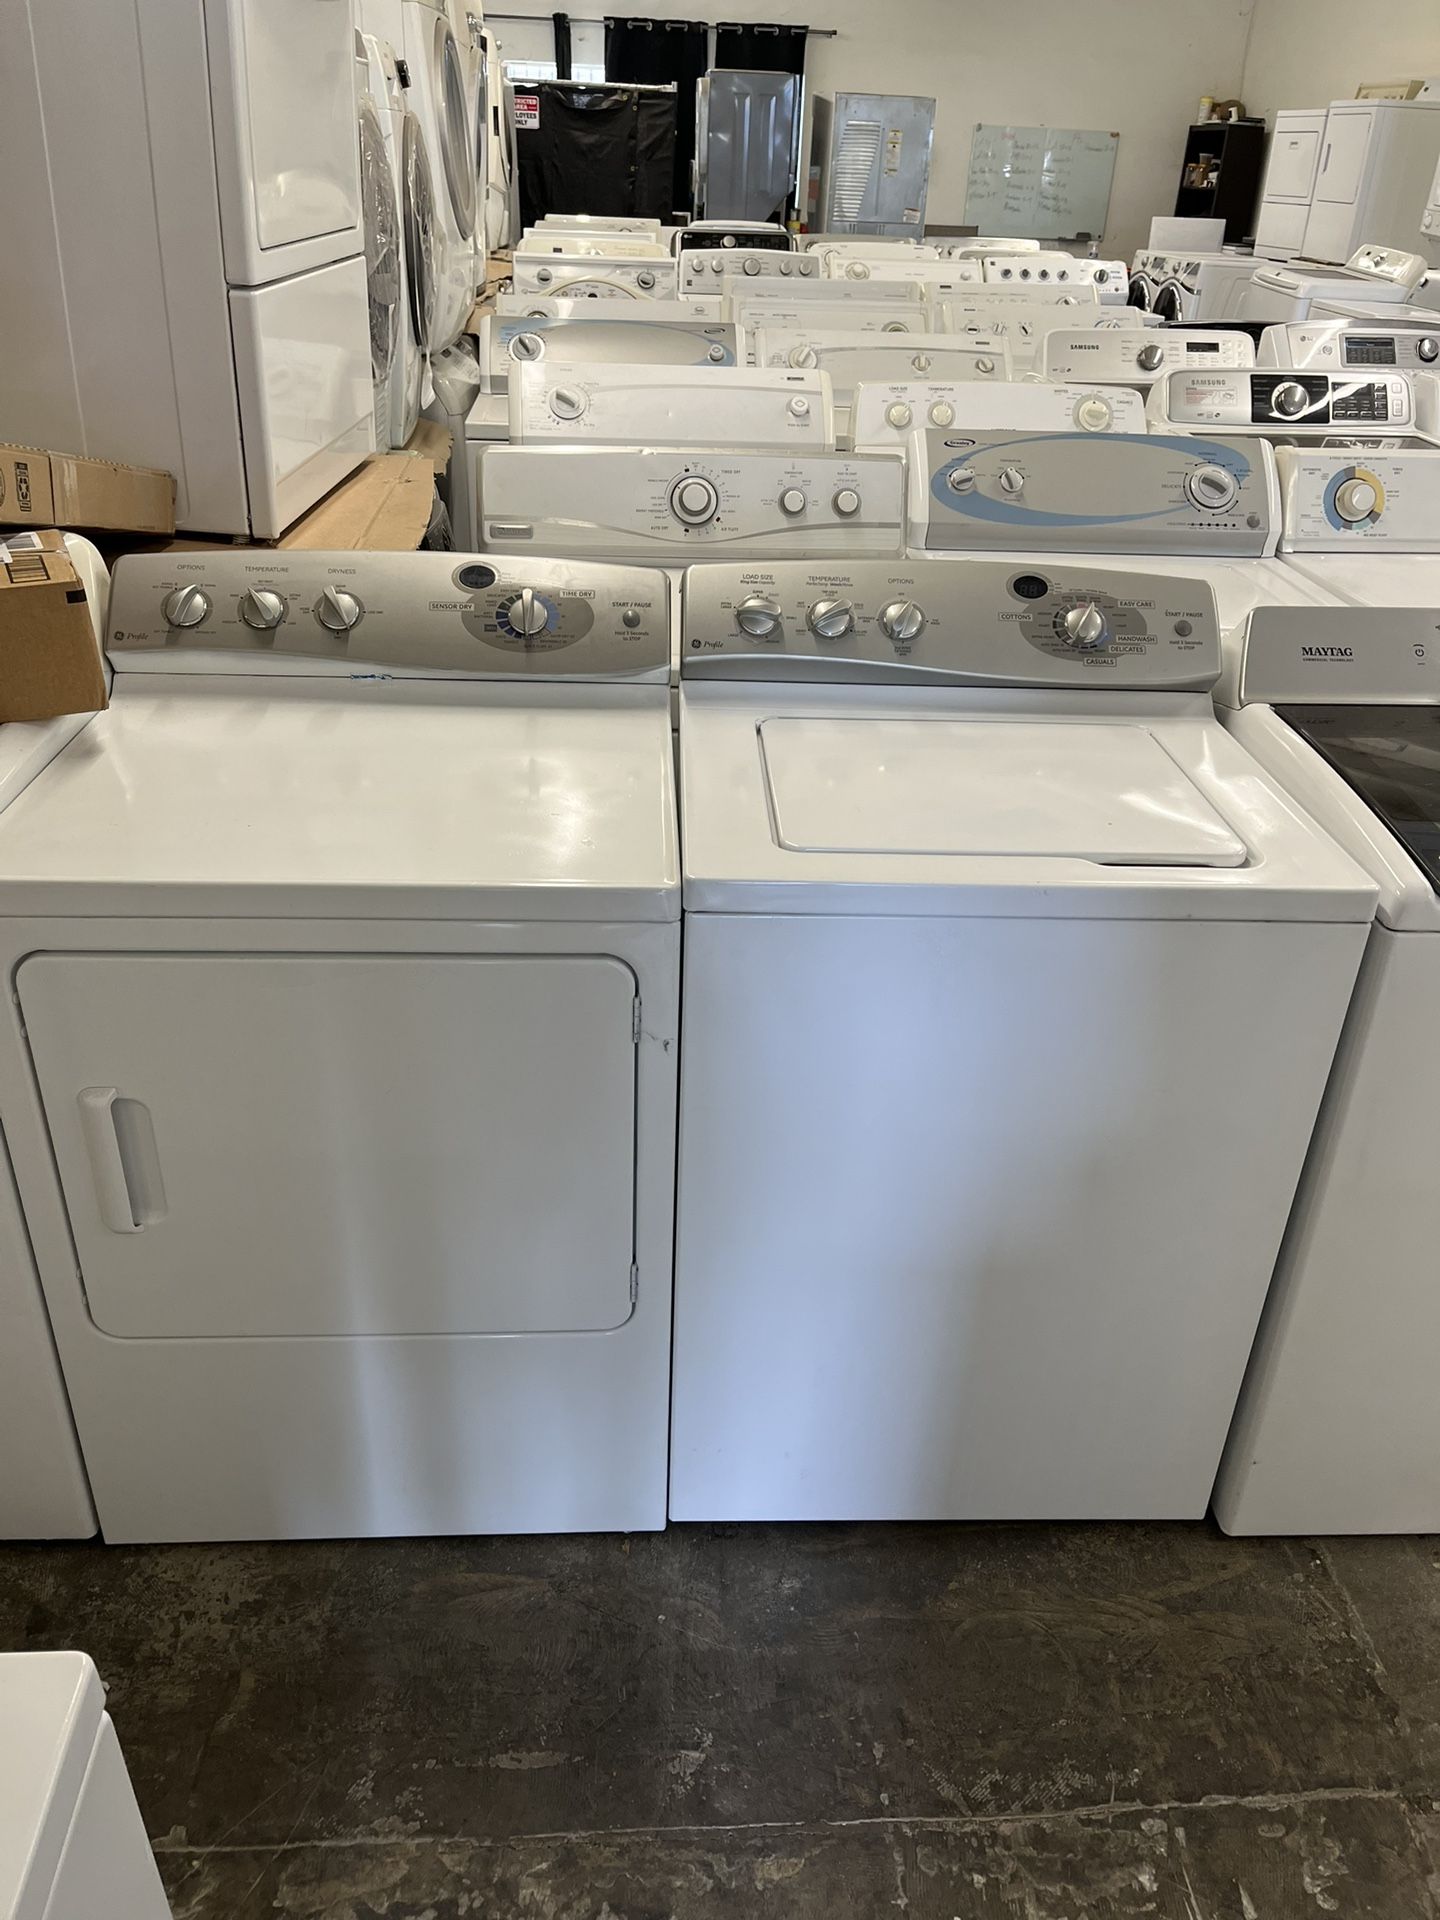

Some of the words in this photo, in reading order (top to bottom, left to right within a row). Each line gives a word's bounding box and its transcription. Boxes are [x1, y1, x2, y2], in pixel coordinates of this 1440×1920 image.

[808, 575, 851, 583] TEMPERATURE
[127, 632, 149, 642] Profile
[704, 640, 724, 650] Profile
[1110, 645, 1143, 653] DELICATES
[1301, 646, 1353, 657] MAYTAG
